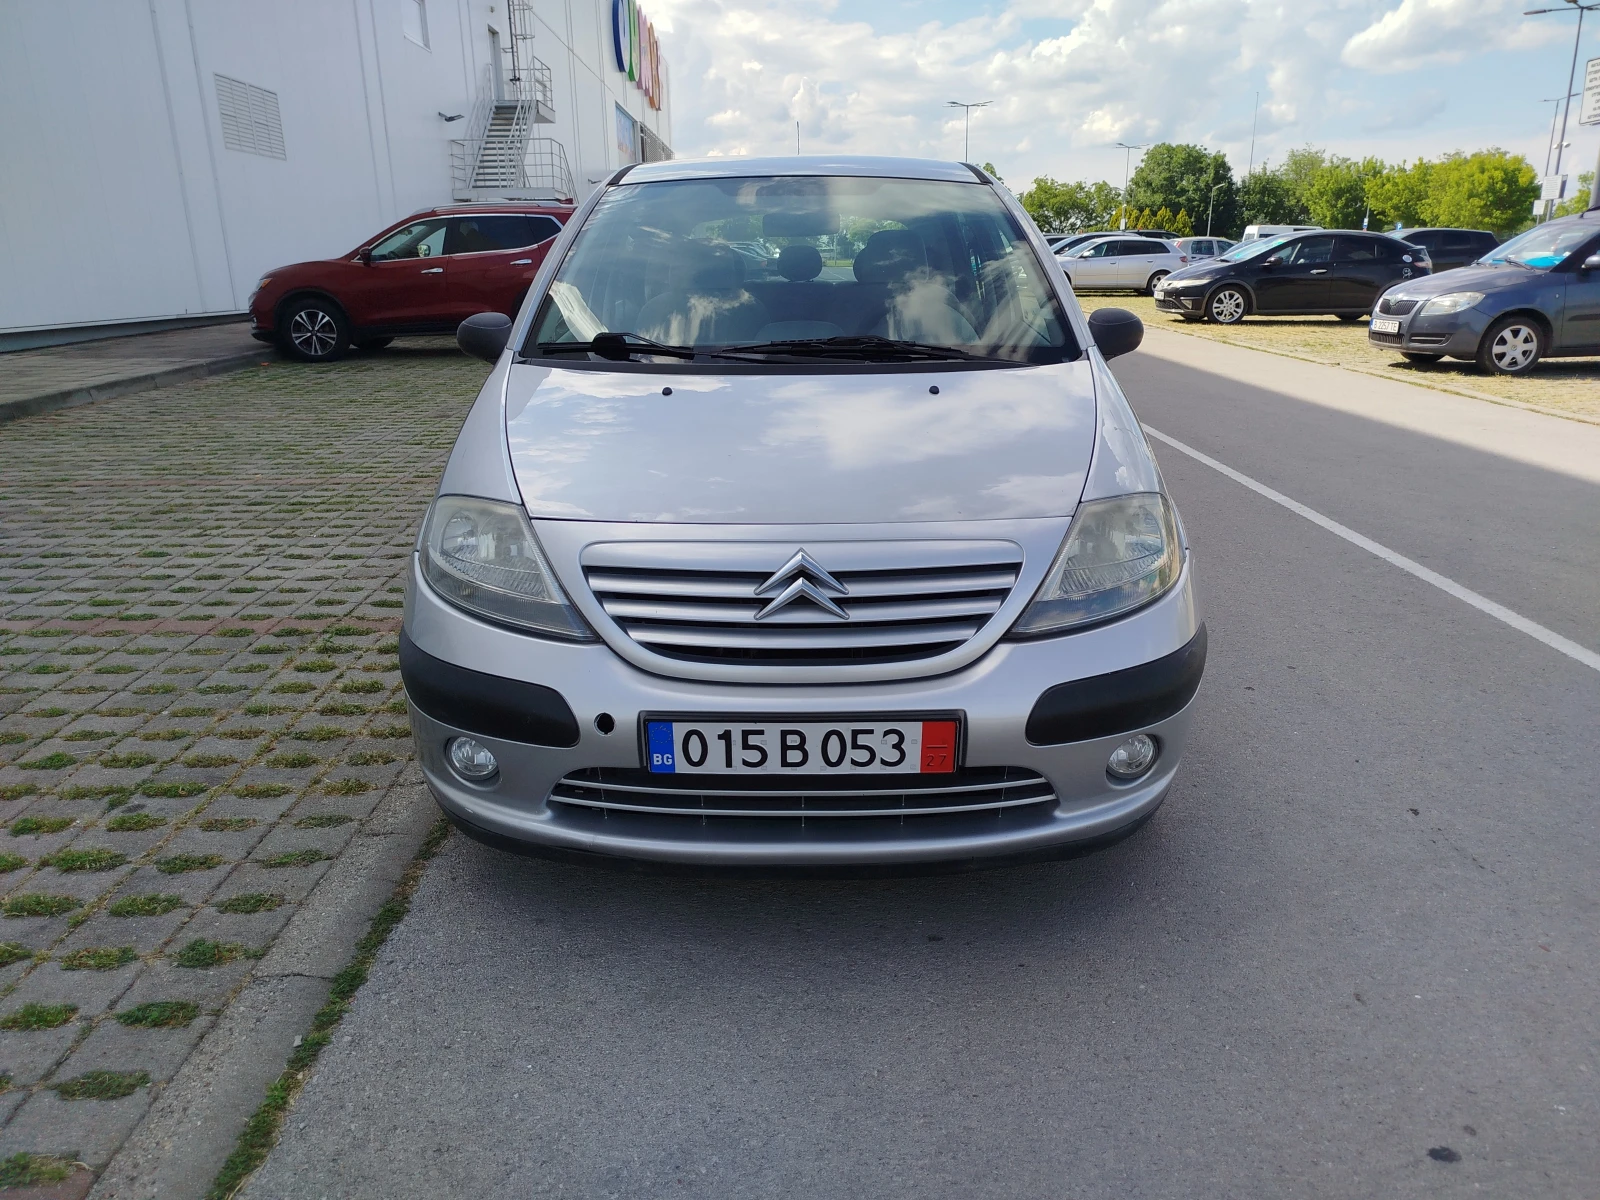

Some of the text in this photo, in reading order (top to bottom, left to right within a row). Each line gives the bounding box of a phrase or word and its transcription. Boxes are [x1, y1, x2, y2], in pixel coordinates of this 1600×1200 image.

[1391, 322, 1398, 331] TE
[682, 728, 906, 768] 015 B 053
[653, 753, 673, 765] BG
[926, 753, 947, 767] 27
